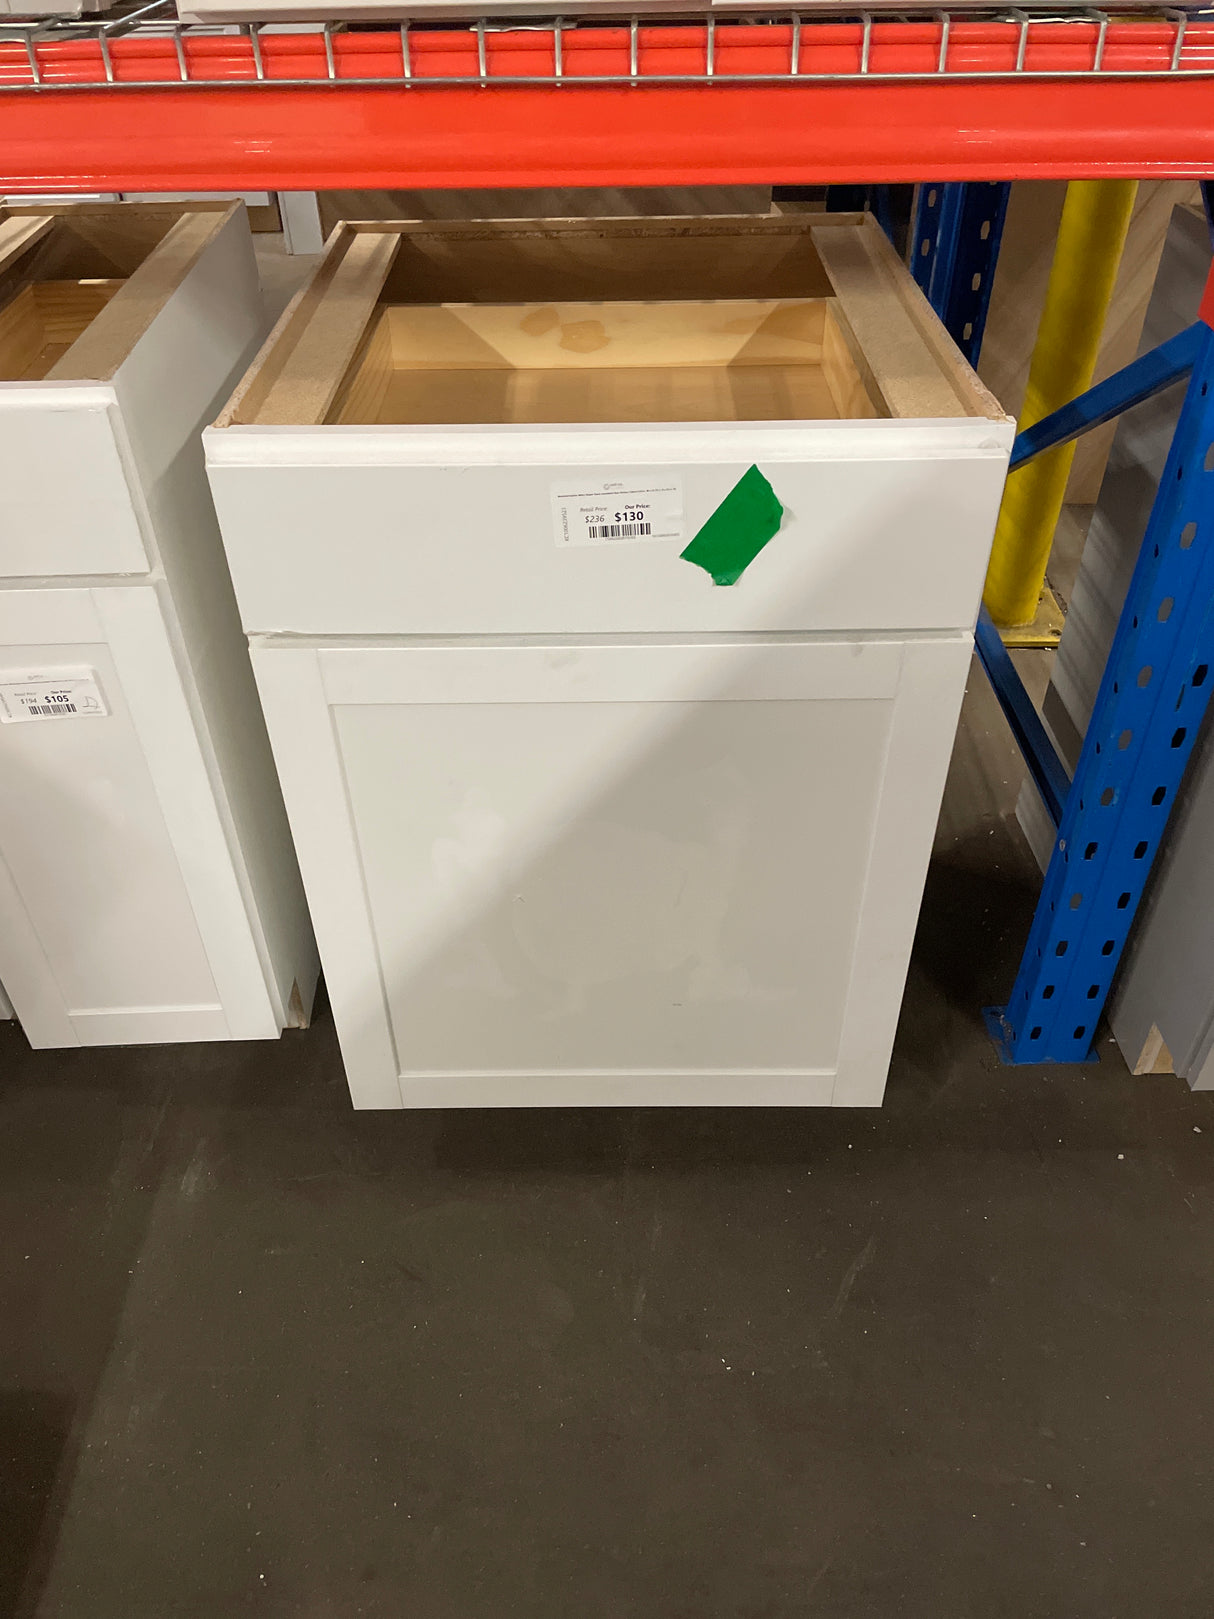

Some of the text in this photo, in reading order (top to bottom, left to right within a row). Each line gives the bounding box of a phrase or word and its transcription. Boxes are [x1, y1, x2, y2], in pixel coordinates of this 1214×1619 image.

[585, 514, 605, 523] $236
[614, 511, 644, 522] $130
[44, 695, 69, 703] $105
